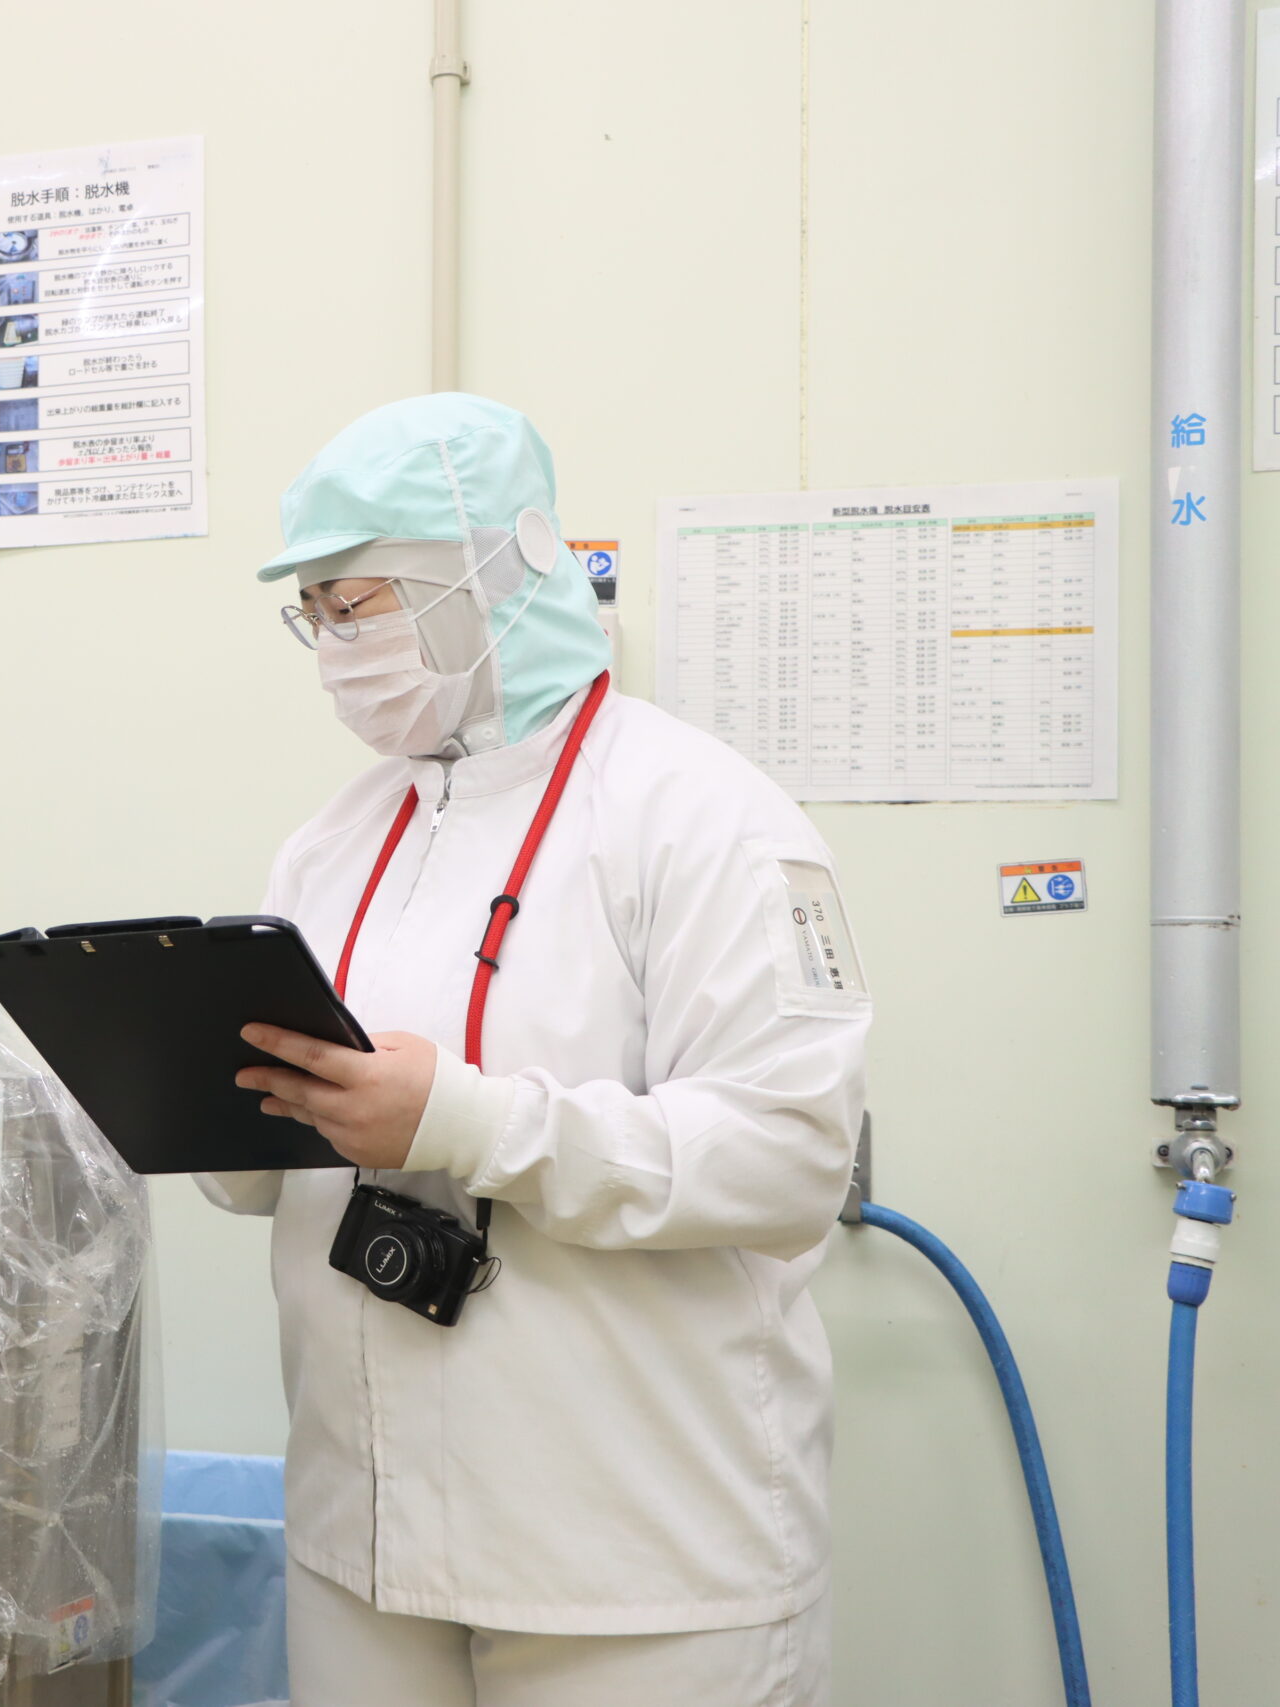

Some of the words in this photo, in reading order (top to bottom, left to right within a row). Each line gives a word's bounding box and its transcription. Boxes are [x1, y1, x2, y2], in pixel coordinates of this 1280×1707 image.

[10, 180, 131, 208] 脱水手順：脱水機
[1170, 411, 1207, 527] 給水
[801, 928, 814, 962] YAMATO
[810, 899, 825, 923] 370
[820, 934, 836, 961] 三田
[374, 1199, 397, 1217] LUMIX
[376, 1246, 396, 1274] LUMIX
